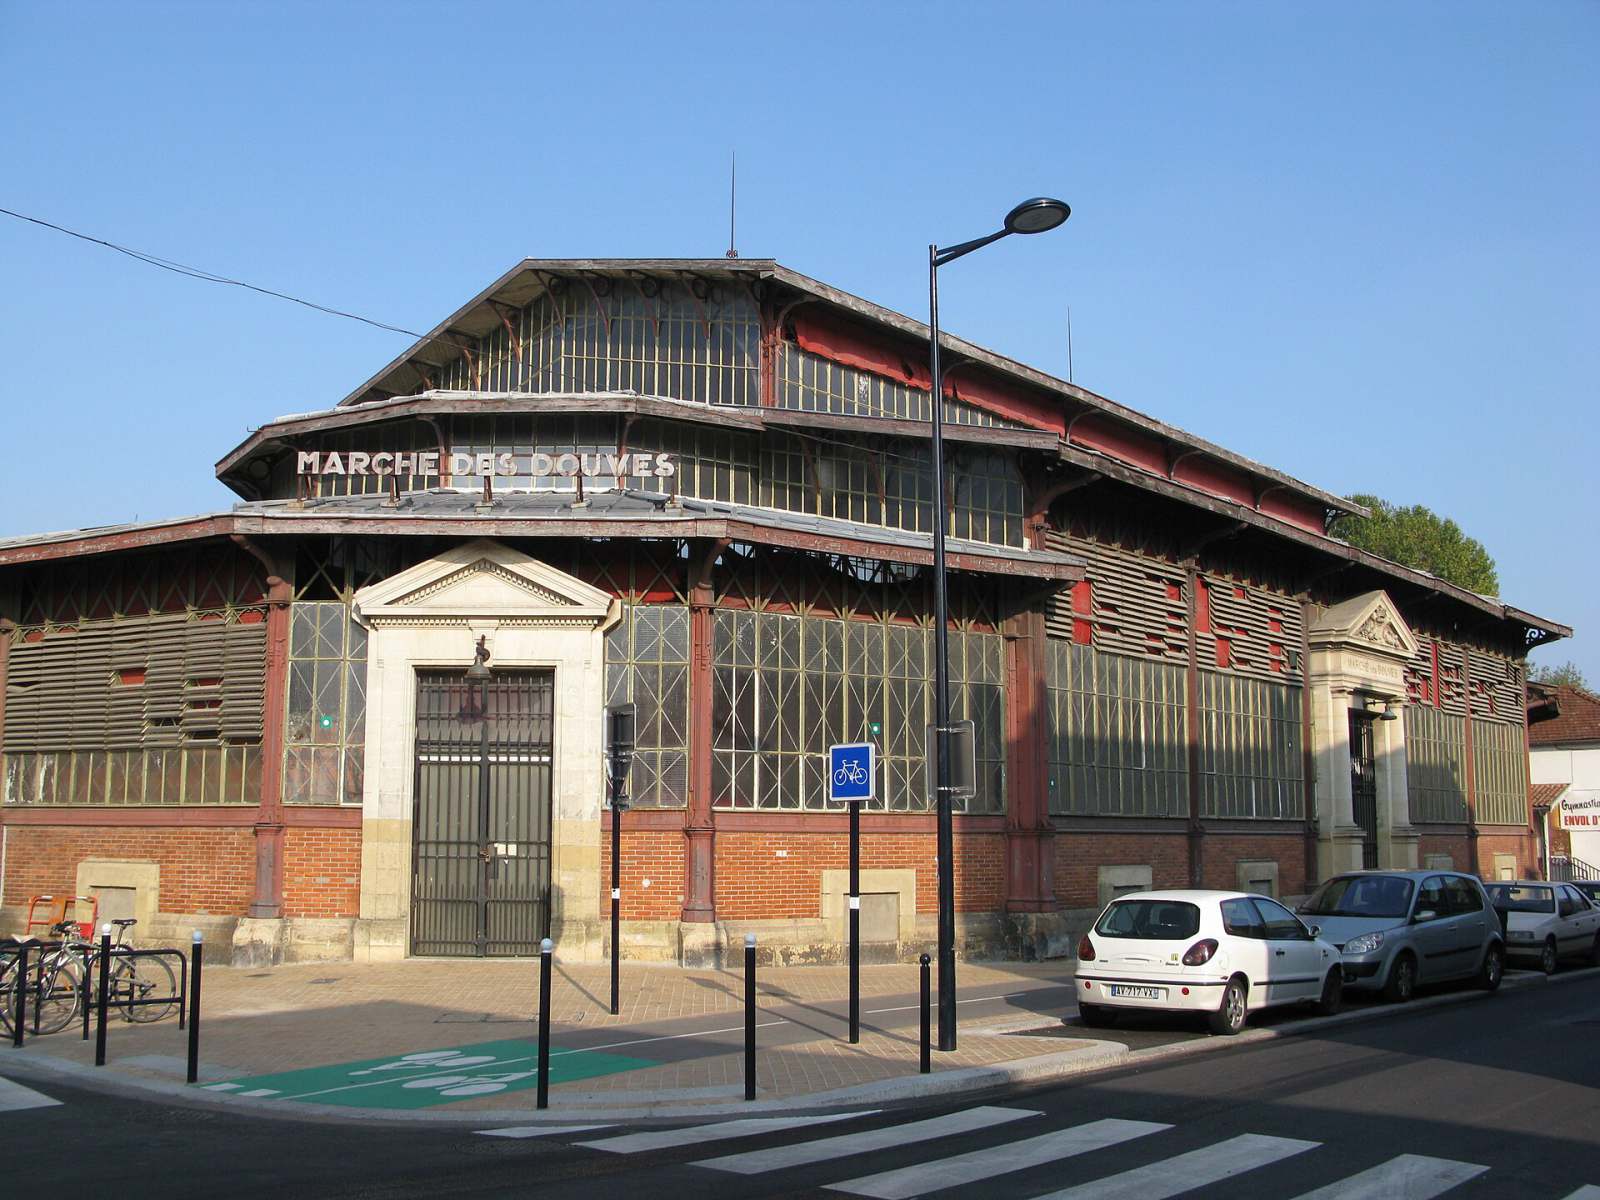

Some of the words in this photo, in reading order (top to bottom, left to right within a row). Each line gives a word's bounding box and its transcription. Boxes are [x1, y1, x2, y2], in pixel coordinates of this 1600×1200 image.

[296, 451, 439, 475] MARCHE
[452, 453, 517, 476] DES
[530, 453, 675, 477] DOUVES
[1564, 815, 1590, 826] ENVOL
